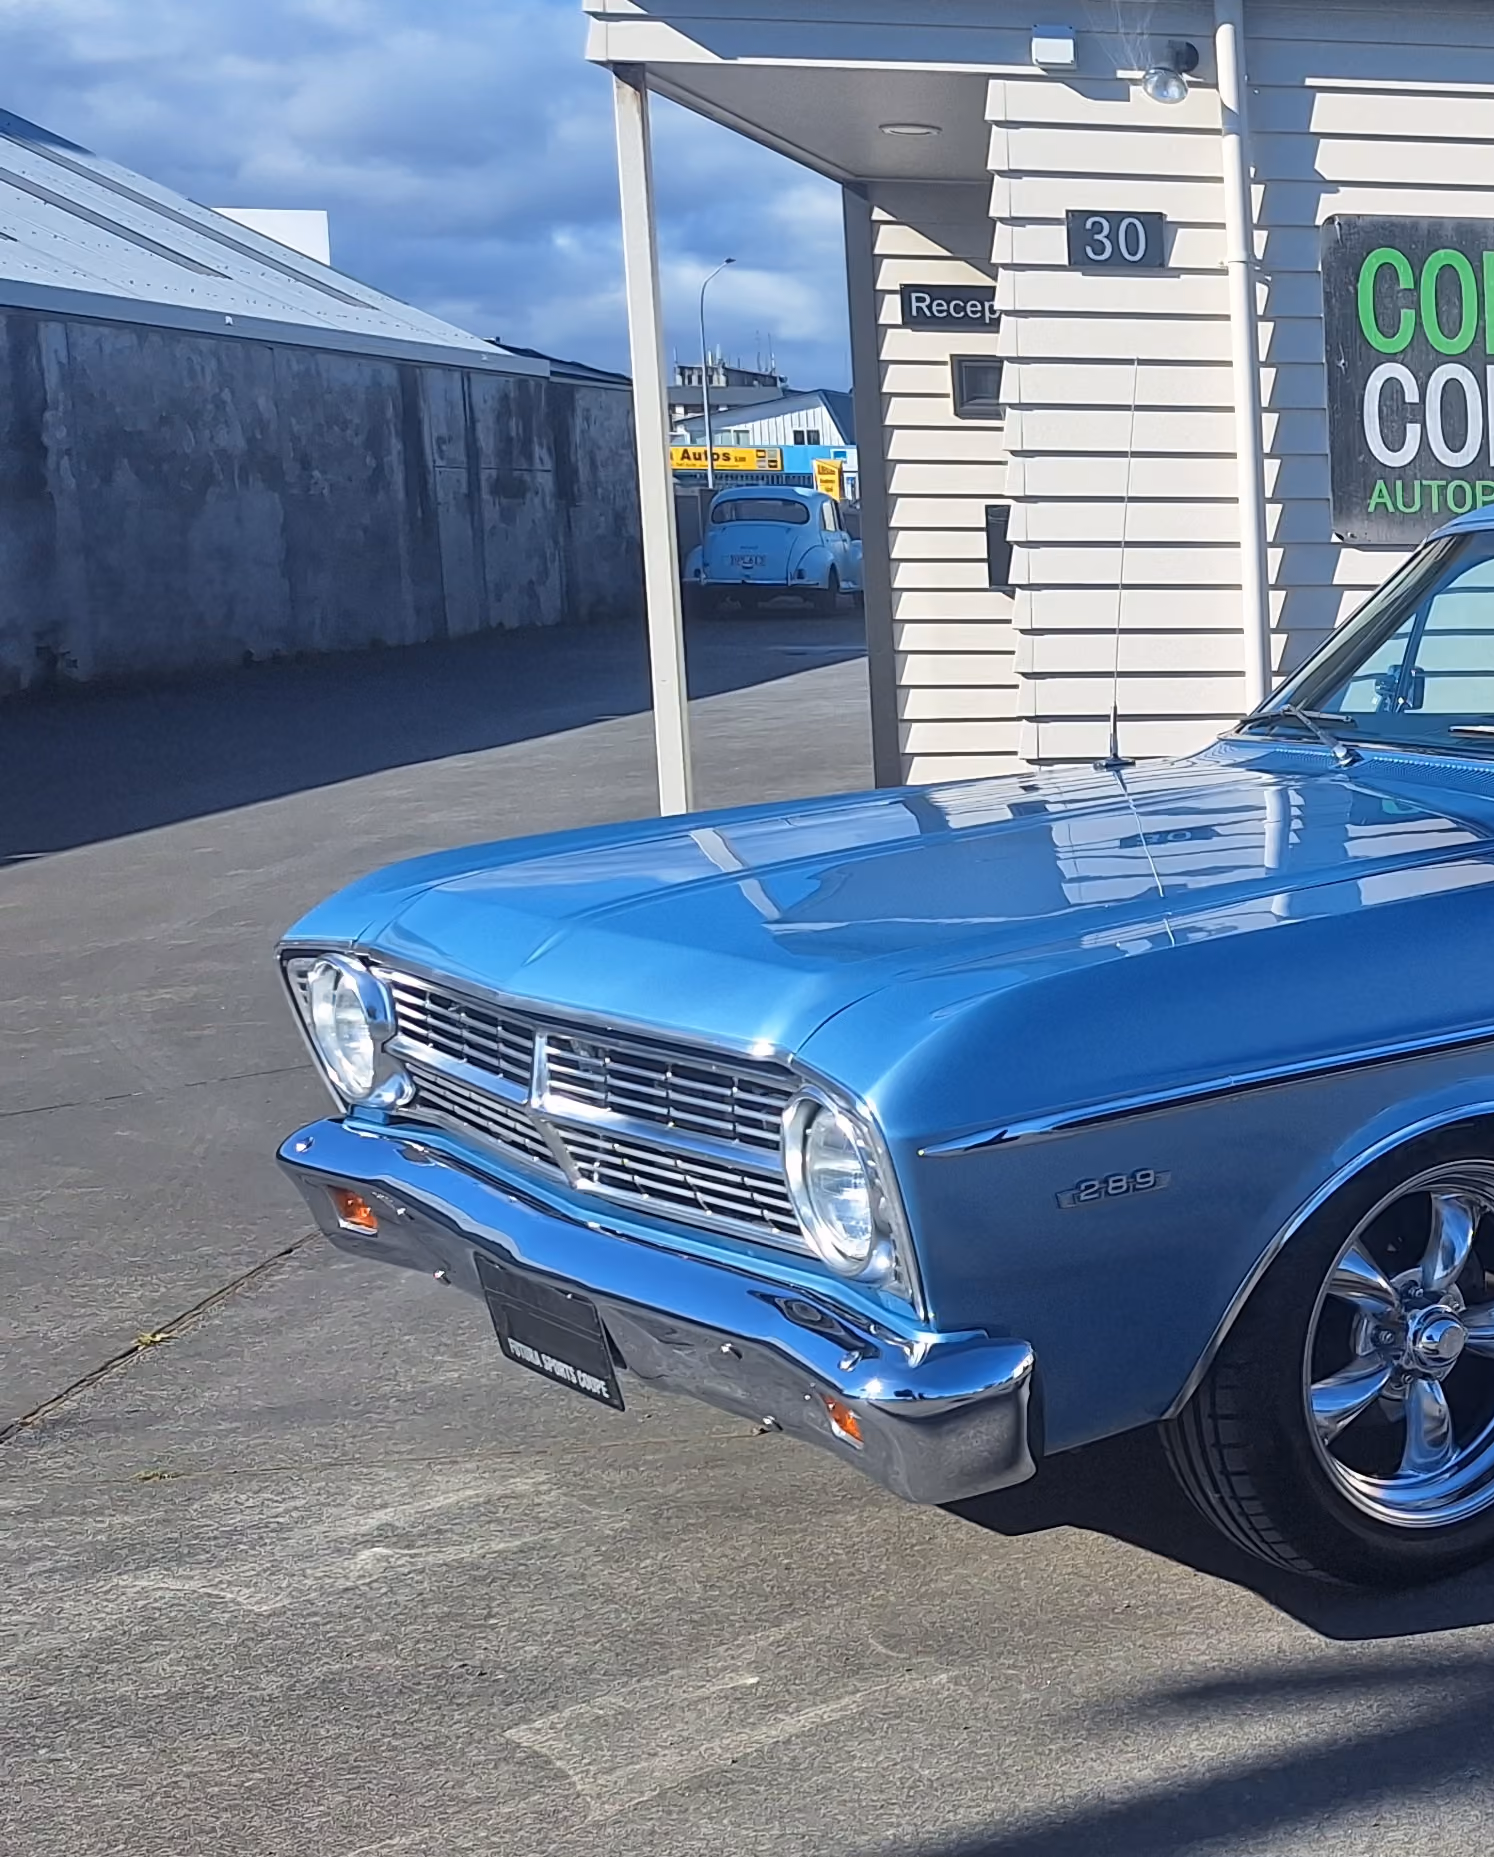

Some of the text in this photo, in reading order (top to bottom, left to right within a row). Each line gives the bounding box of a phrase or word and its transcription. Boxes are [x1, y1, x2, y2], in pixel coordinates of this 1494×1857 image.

[1085, 216, 1147, 262] 30
[910, 292, 1000, 324] Recep
[1080, 1169, 1155, 1201] 289
